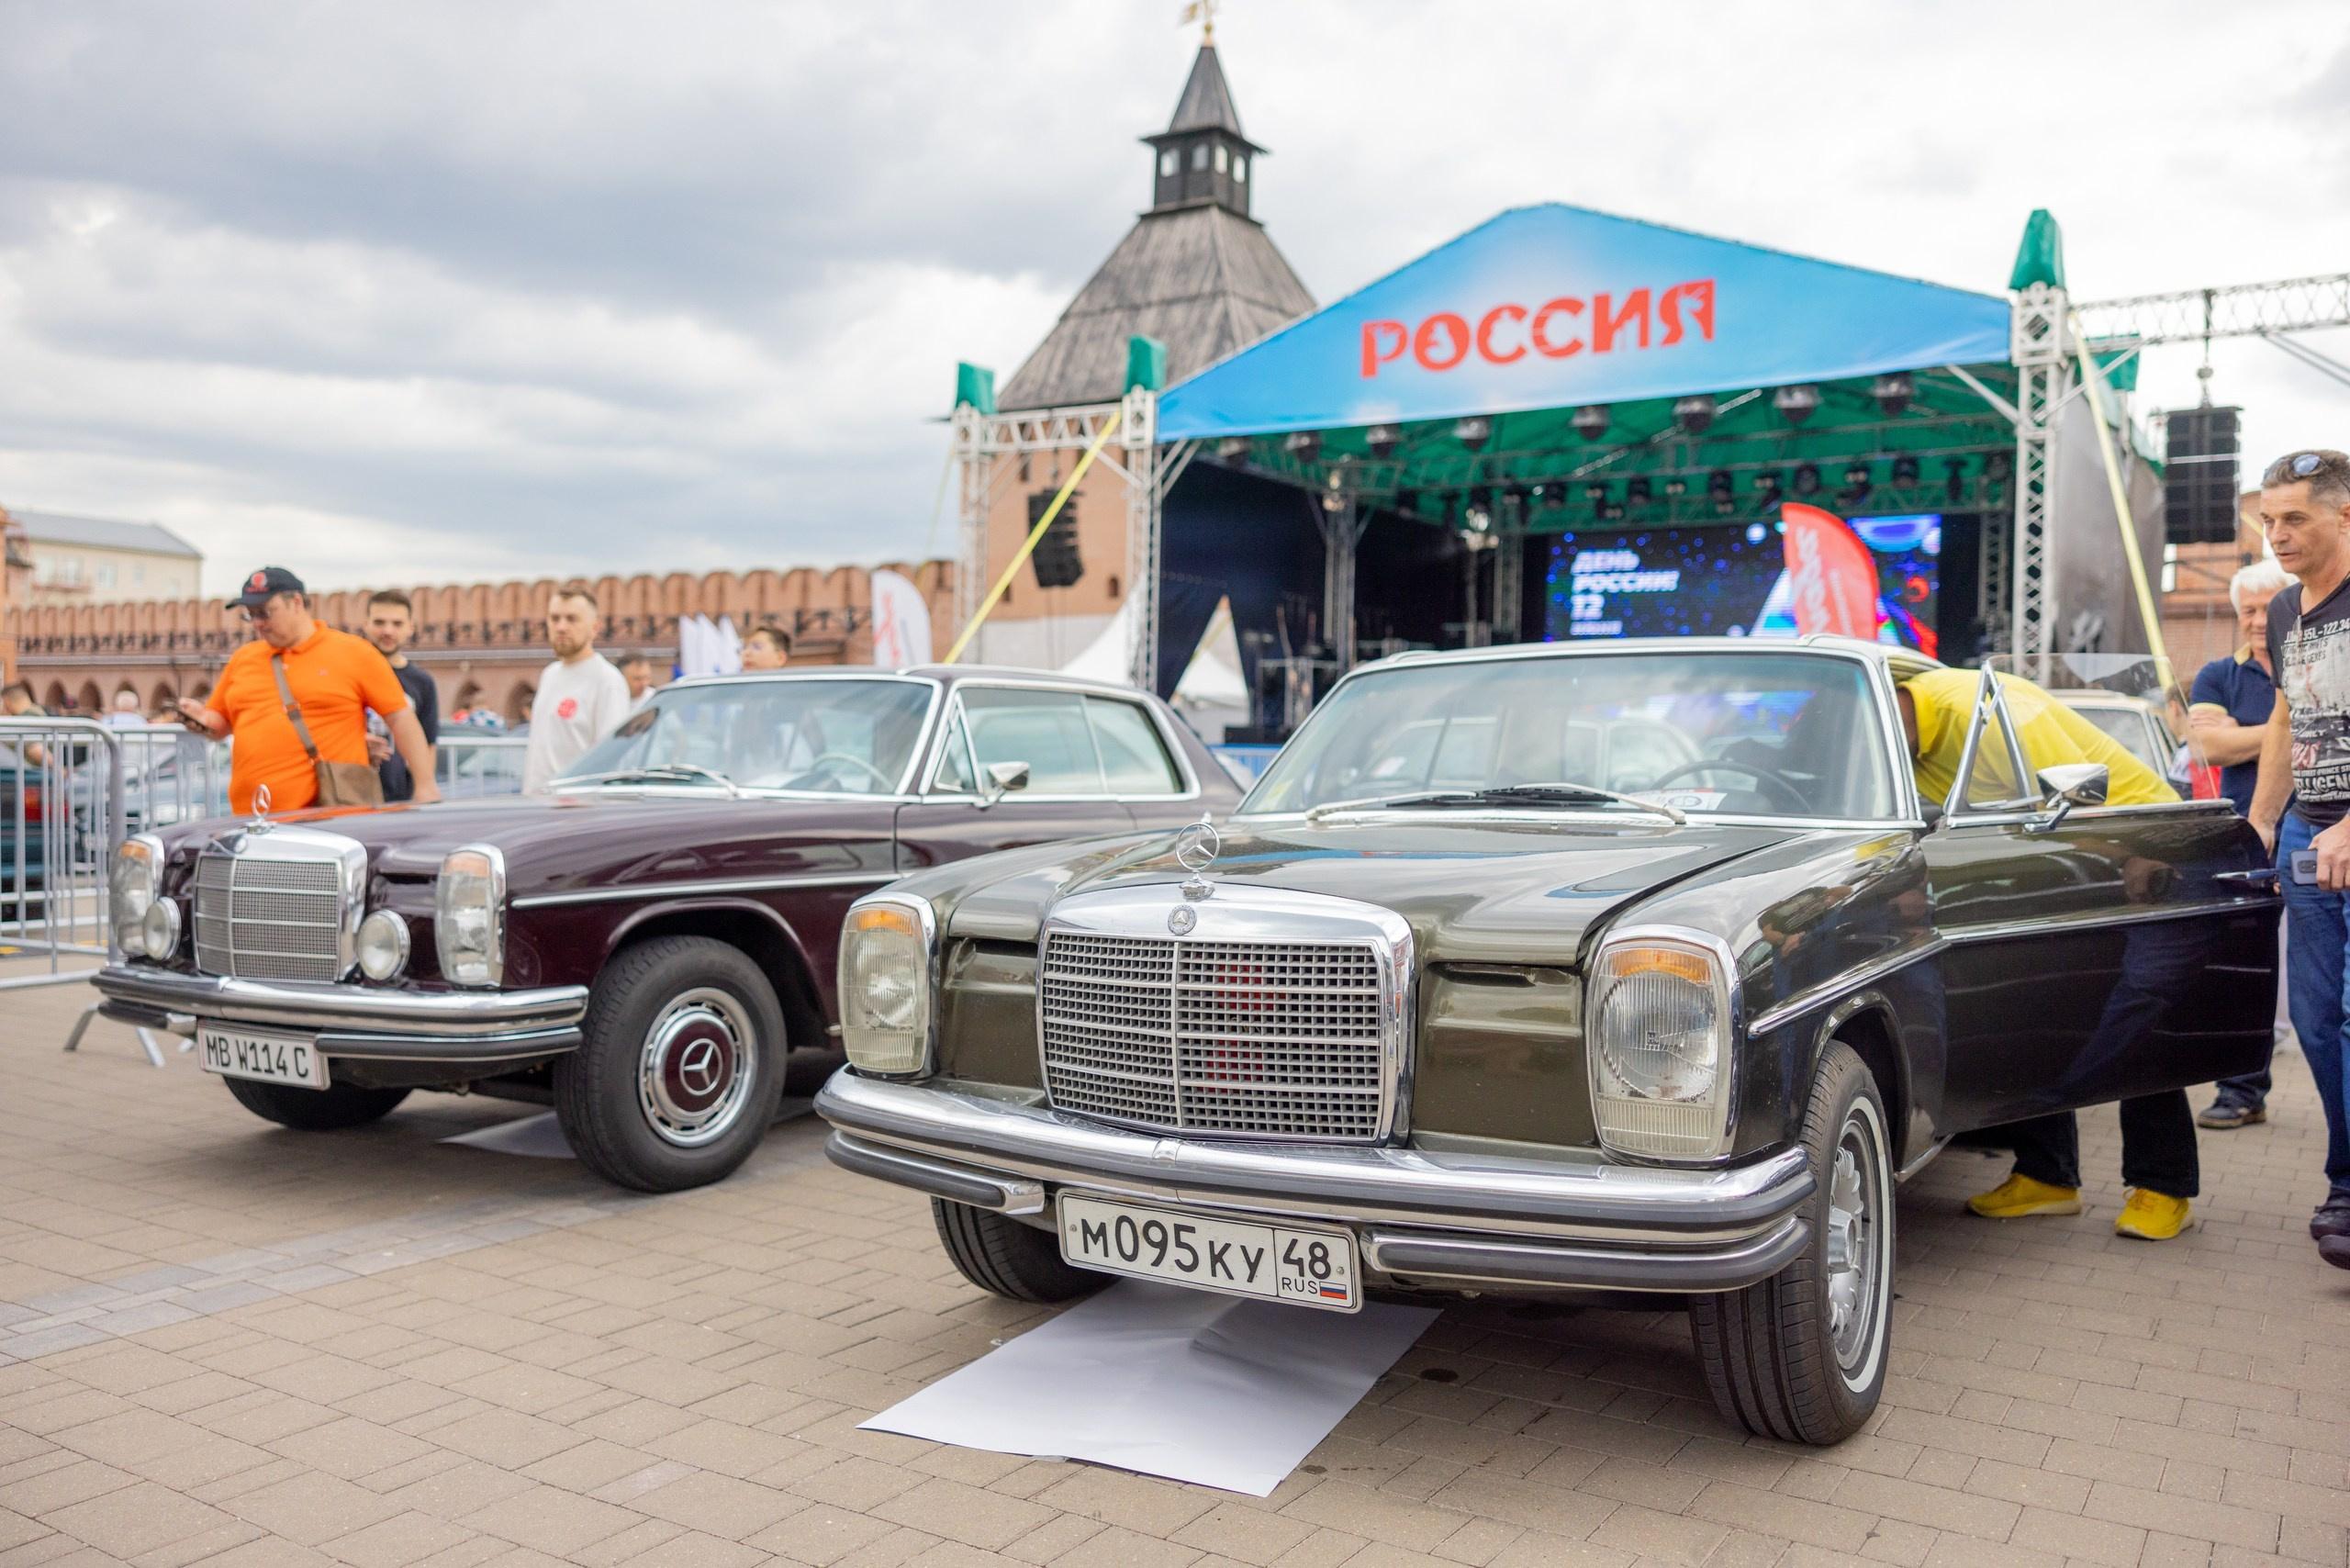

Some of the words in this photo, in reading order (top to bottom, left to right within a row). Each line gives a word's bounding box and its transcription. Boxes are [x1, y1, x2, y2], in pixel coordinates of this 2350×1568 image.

[1360, 278, 1716, 378] РОССИЯ
[1570, 593, 1606, 620] 12
[206, 1035, 230, 1067] MB
[235, 1039, 287, 1076] W114
[294, 1047, 308, 1078] C
[1080, 1215, 1265, 1283] М095КУ
[1281, 1238, 1332, 1280] 48
[1281, 1277, 1318, 1294] RUS
